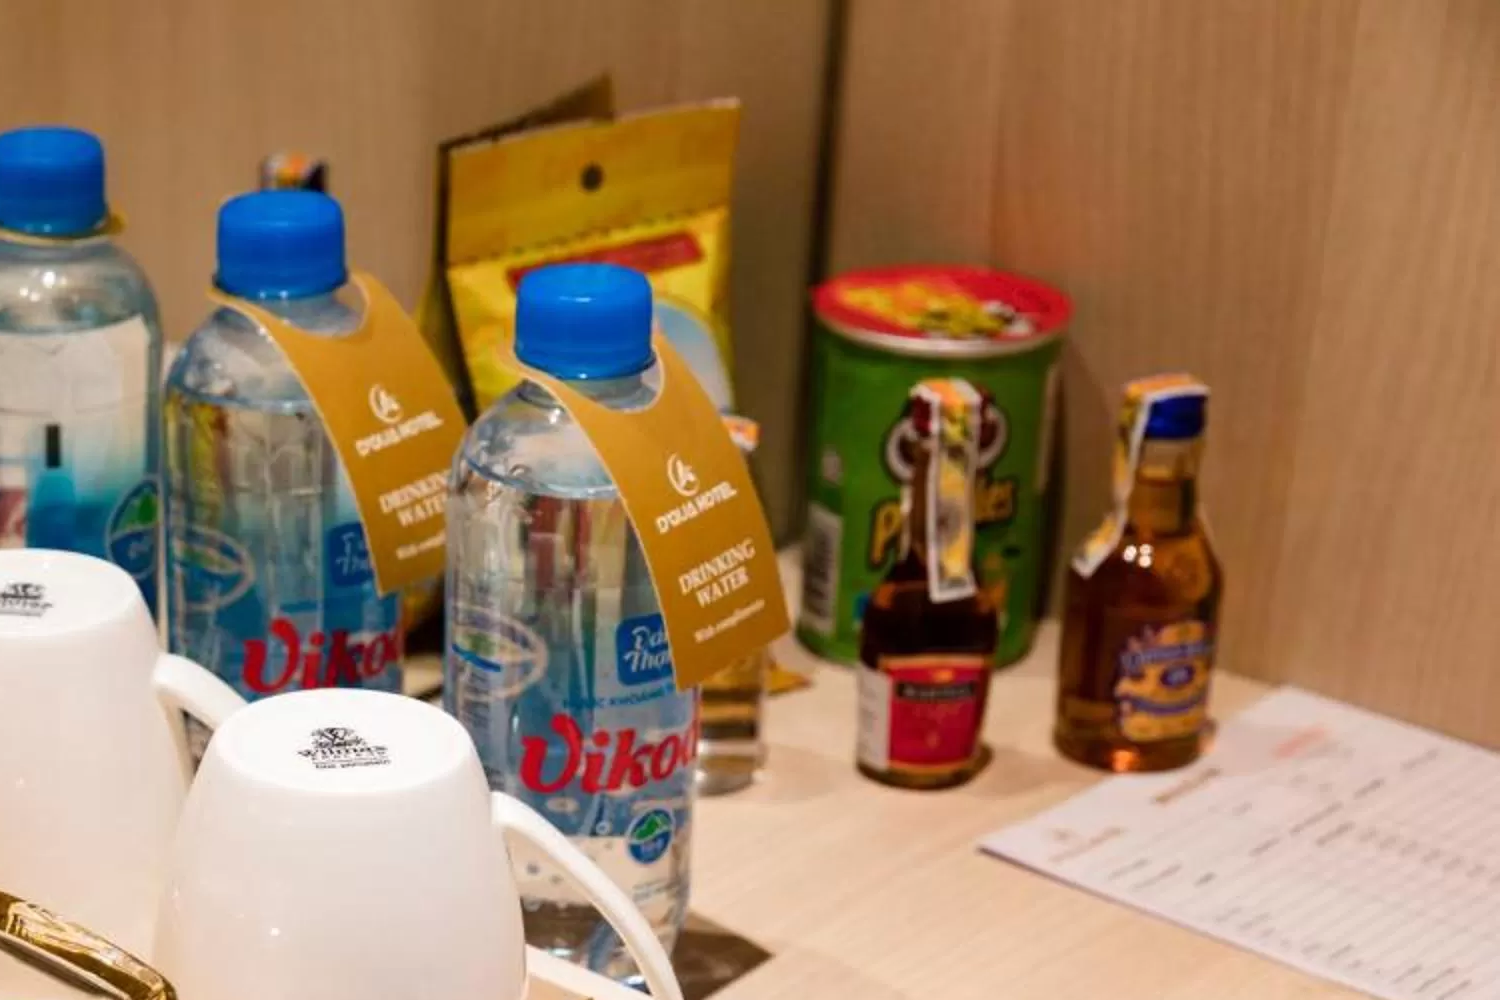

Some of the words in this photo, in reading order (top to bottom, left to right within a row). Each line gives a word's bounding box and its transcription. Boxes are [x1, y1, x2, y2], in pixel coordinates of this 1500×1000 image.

[379, 468, 450, 514] DRINKIN
[696, 481, 738, 513] HOTEL
[678, 537, 756, 596] DRINKING
[696, 566, 749, 608] WATER
